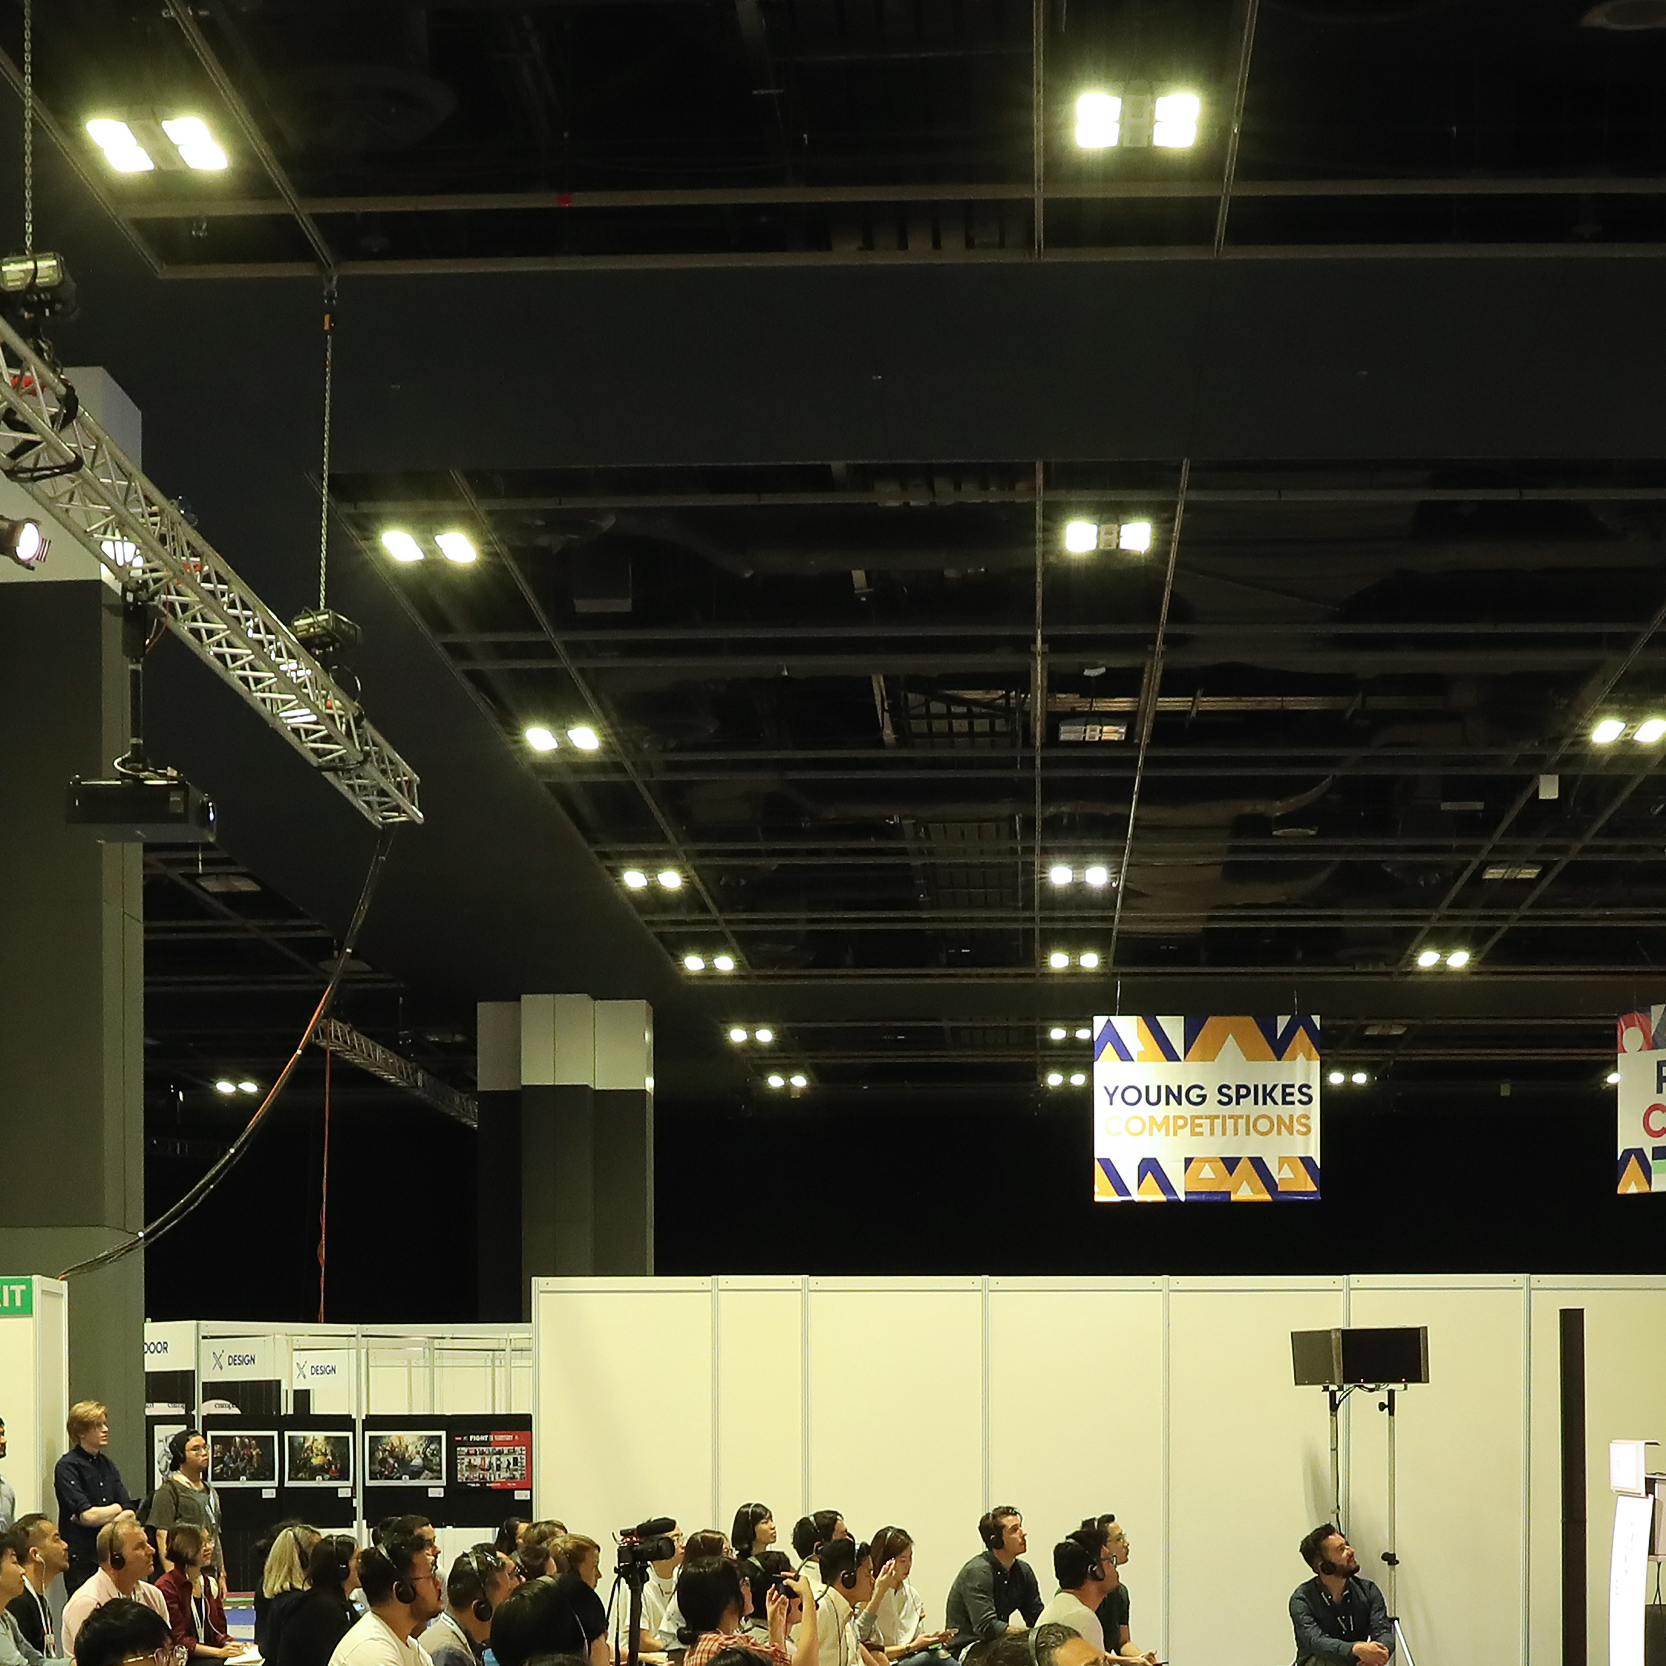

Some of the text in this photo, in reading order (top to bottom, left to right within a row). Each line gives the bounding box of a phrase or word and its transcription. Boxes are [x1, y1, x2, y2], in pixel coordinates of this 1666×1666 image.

[1103, 1083, 1314, 1107] YOUNG SPIKES
[1104, 1113, 1312, 1137] COMPETITIONS
[227, 1354, 256, 1367] DESIGN
[310, 1364, 337, 1376] DESIGN
